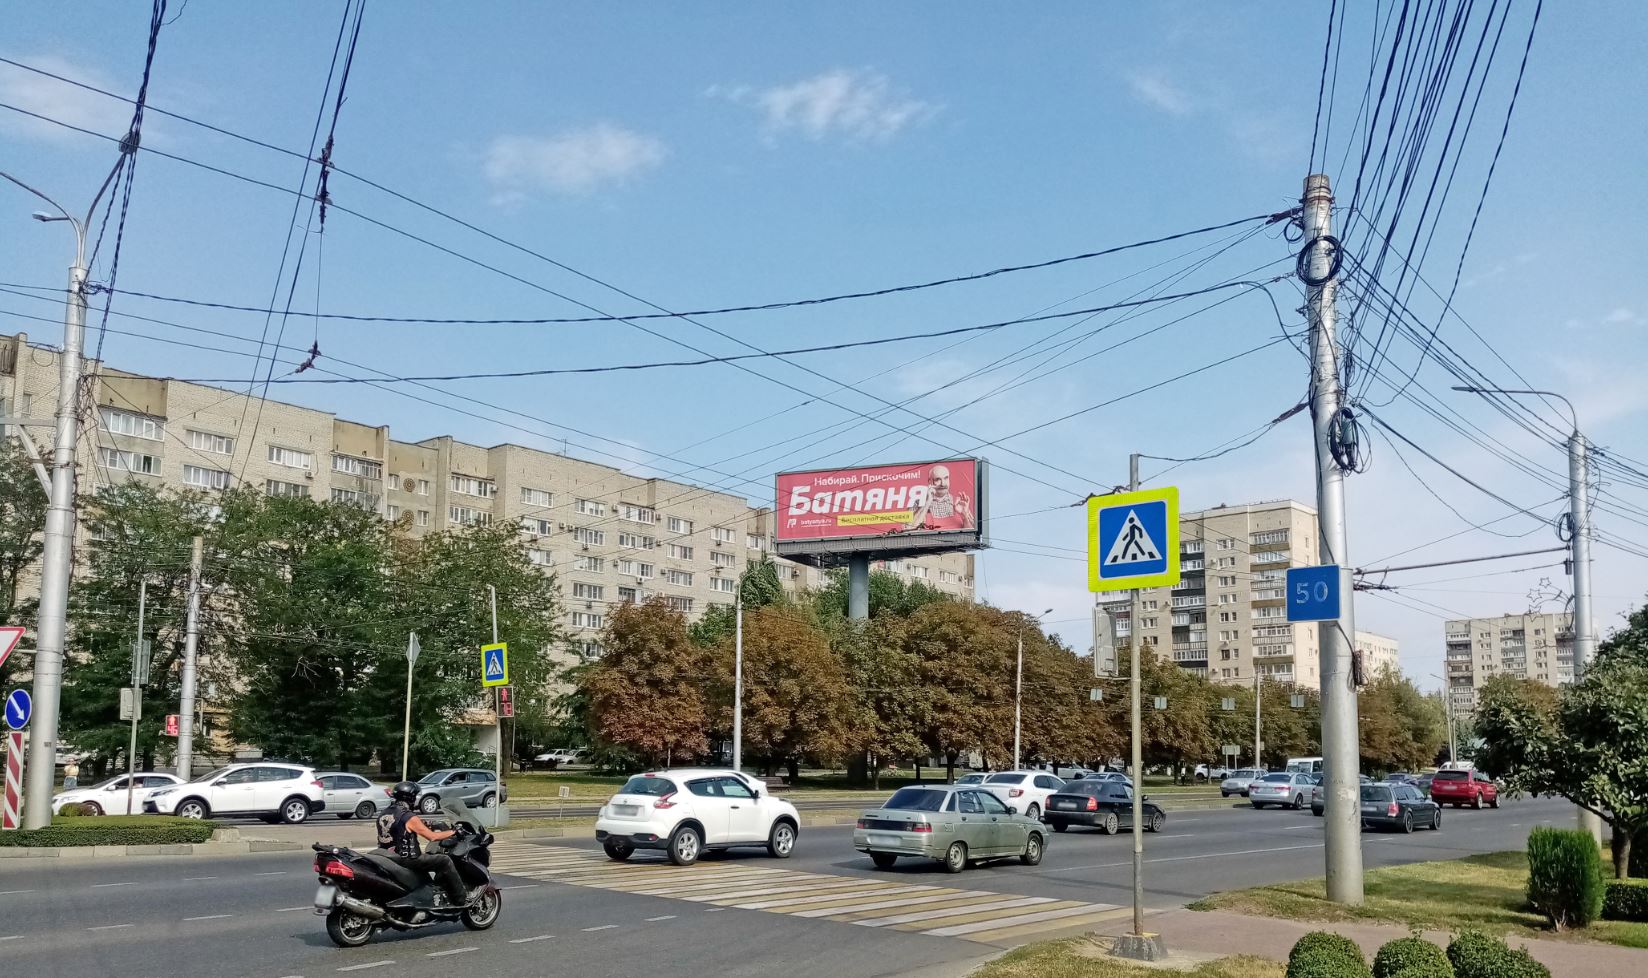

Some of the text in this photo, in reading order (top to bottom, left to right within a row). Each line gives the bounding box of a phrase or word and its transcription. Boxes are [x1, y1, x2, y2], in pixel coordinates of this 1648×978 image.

[814, 470, 921, 487] Набирай. Прискочим!
[788, 485, 929, 516] Батяня
[1296, 581, 1328, 604] 50
